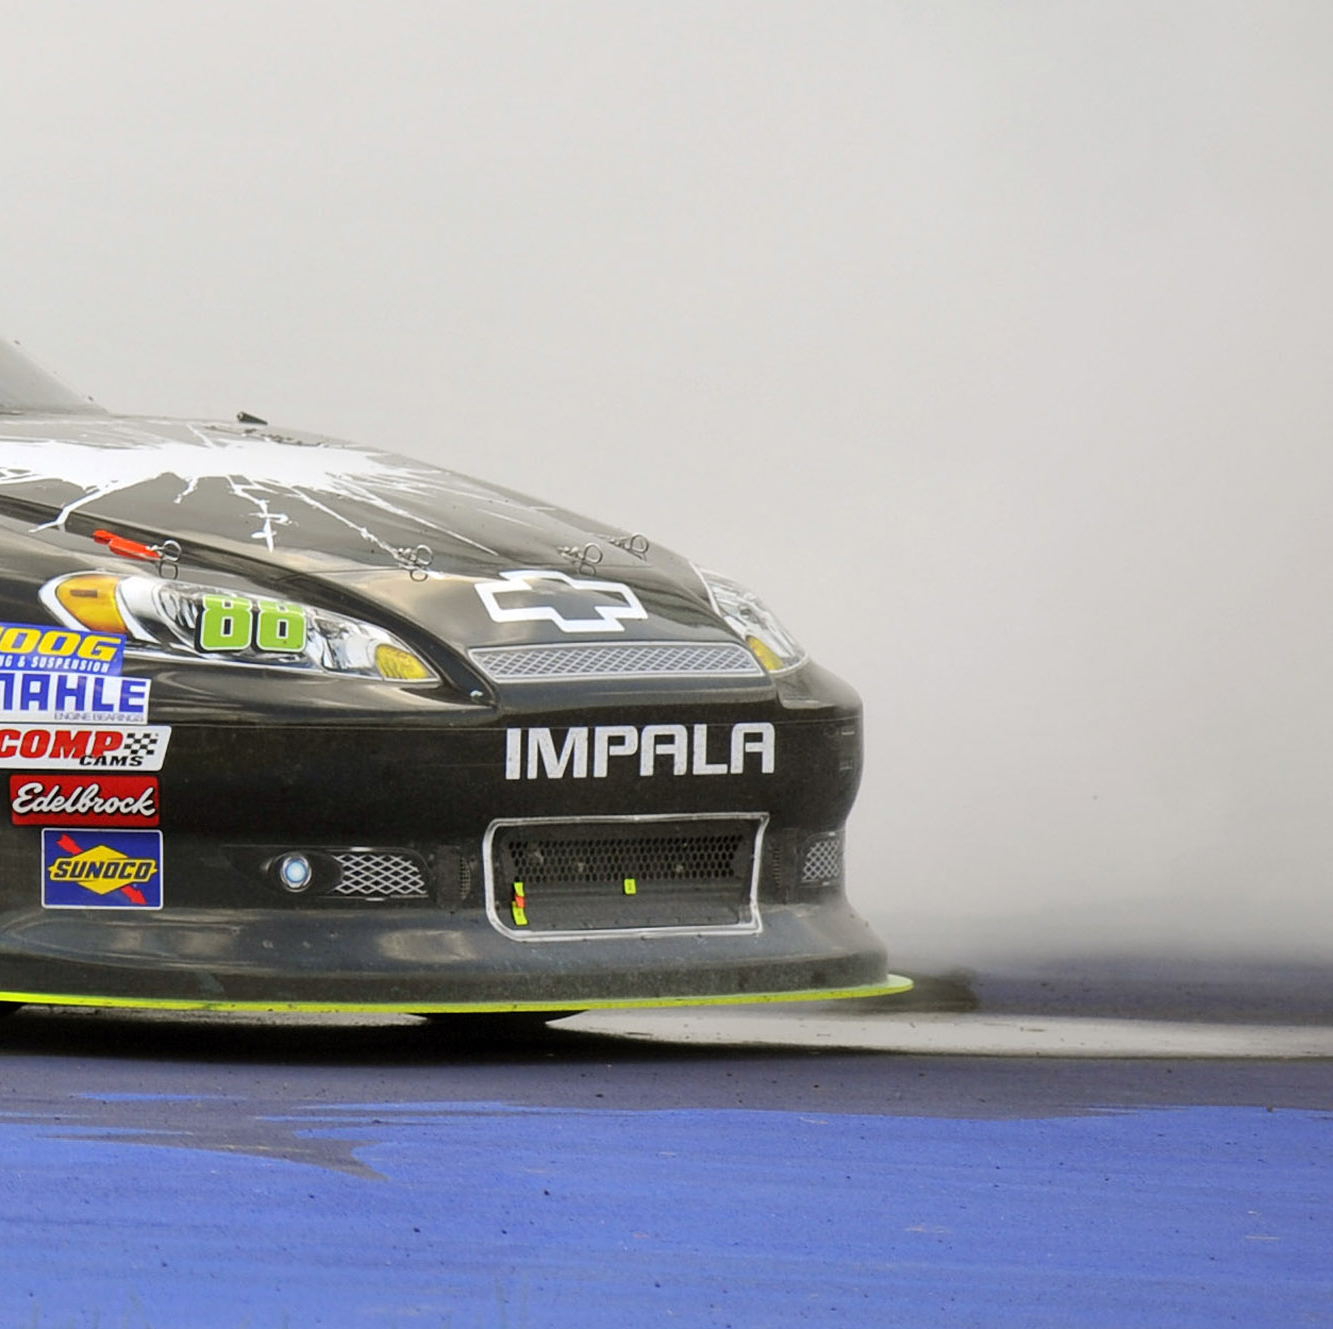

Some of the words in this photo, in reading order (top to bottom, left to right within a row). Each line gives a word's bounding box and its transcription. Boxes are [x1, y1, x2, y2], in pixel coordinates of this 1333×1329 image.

[199, 593, 307, 652] 88
[17, 655, 26, 668] &
[31, 656, 112, 674] SUSPENSION
[53, 712, 91, 722] ENGINE
[92, 712, 145, 723] BEARINGS
[79, 755, 145, 767] CAMS
[505, 722, 775, 780] IMPALA
[11, 782, 157, 817] Edelbrock
[53, 860, 153, 880] SUNOCO
